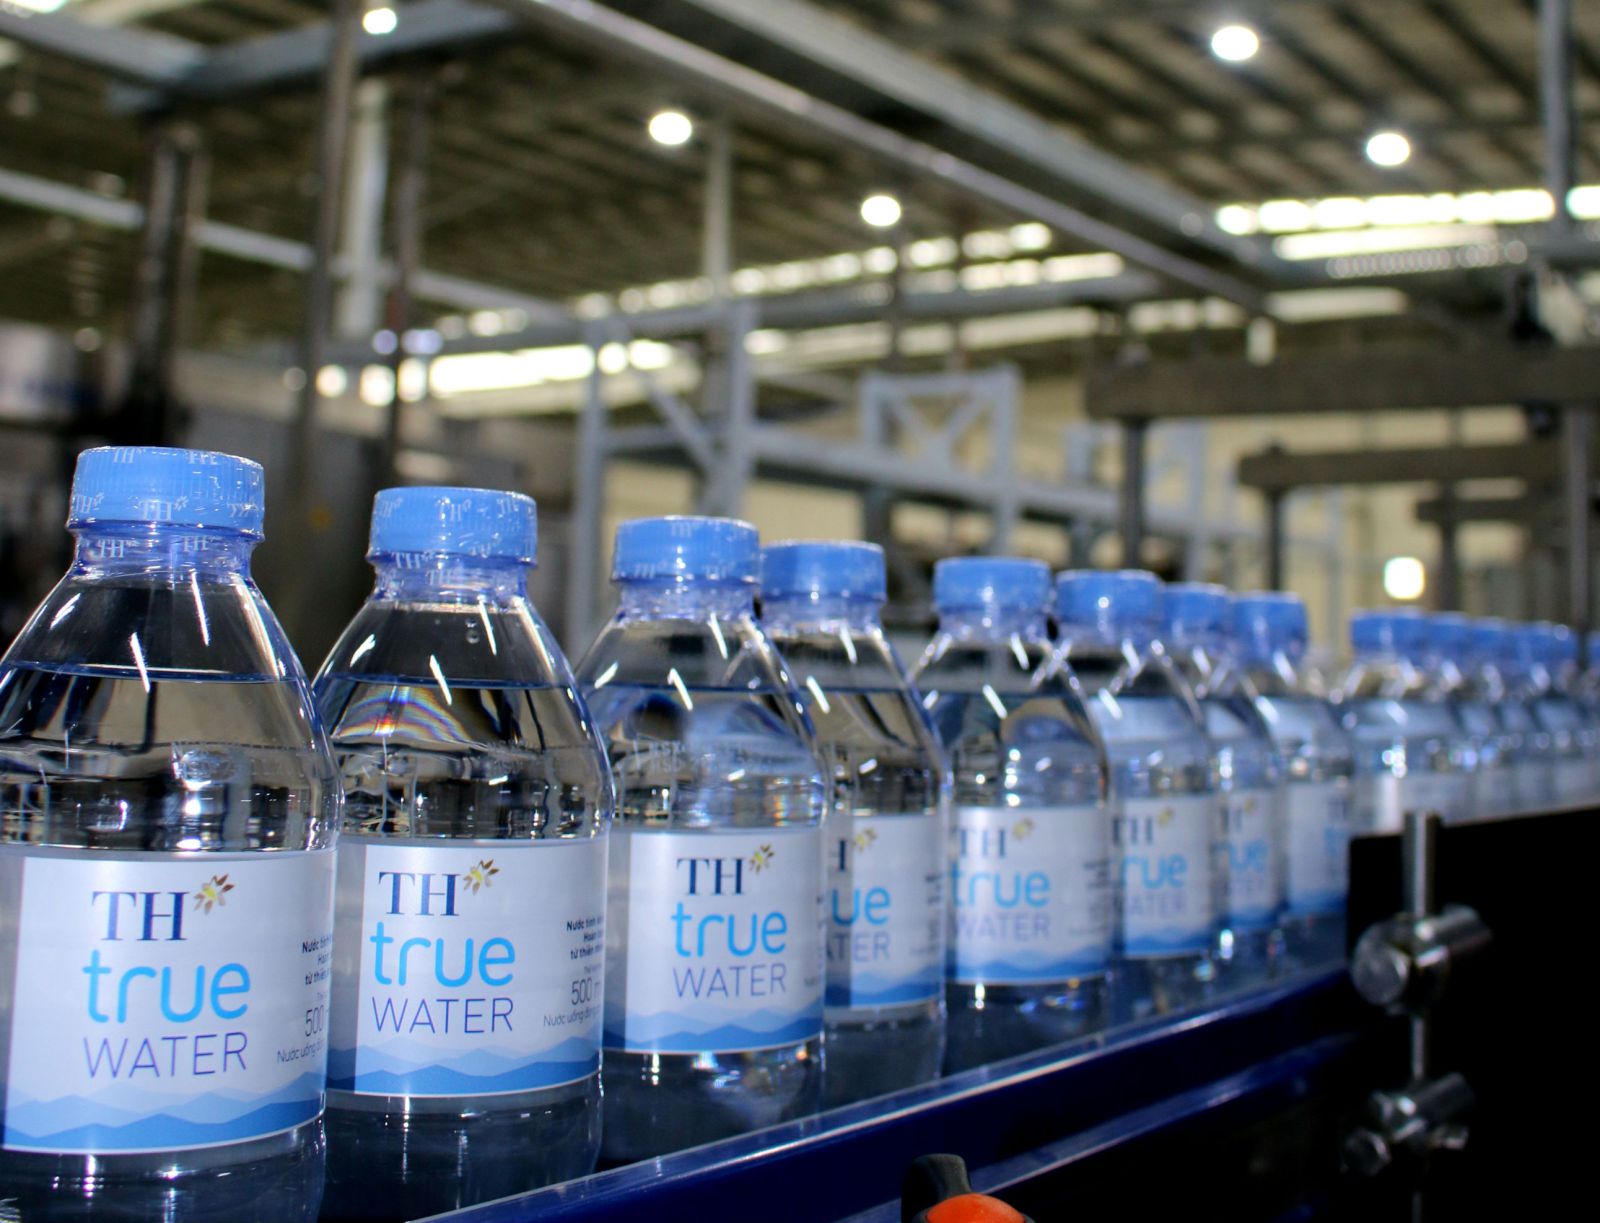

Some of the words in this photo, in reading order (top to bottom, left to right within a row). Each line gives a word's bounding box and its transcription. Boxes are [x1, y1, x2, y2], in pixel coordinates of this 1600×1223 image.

[677, 857, 744, 896] TH
[950, 864, 1050, 908] true
[1120, 854, 1187, 888] rue
[379, 872, 460, 916] TH
[832, 886, 890, 926] ue
[92, 891, 190, 941] TH
[671, 902, 788, 957] true
[370, 922, 515, 987] true
[82, 949, 250, 1023] true
[571, 977, 592, 1005] 500
[673, 963, 786, 998] WATER
[304, 1005, 324, 1037] 500
[372, 996, 514, 1034] WATER
[83, 1031, 248, 1078] WATER
